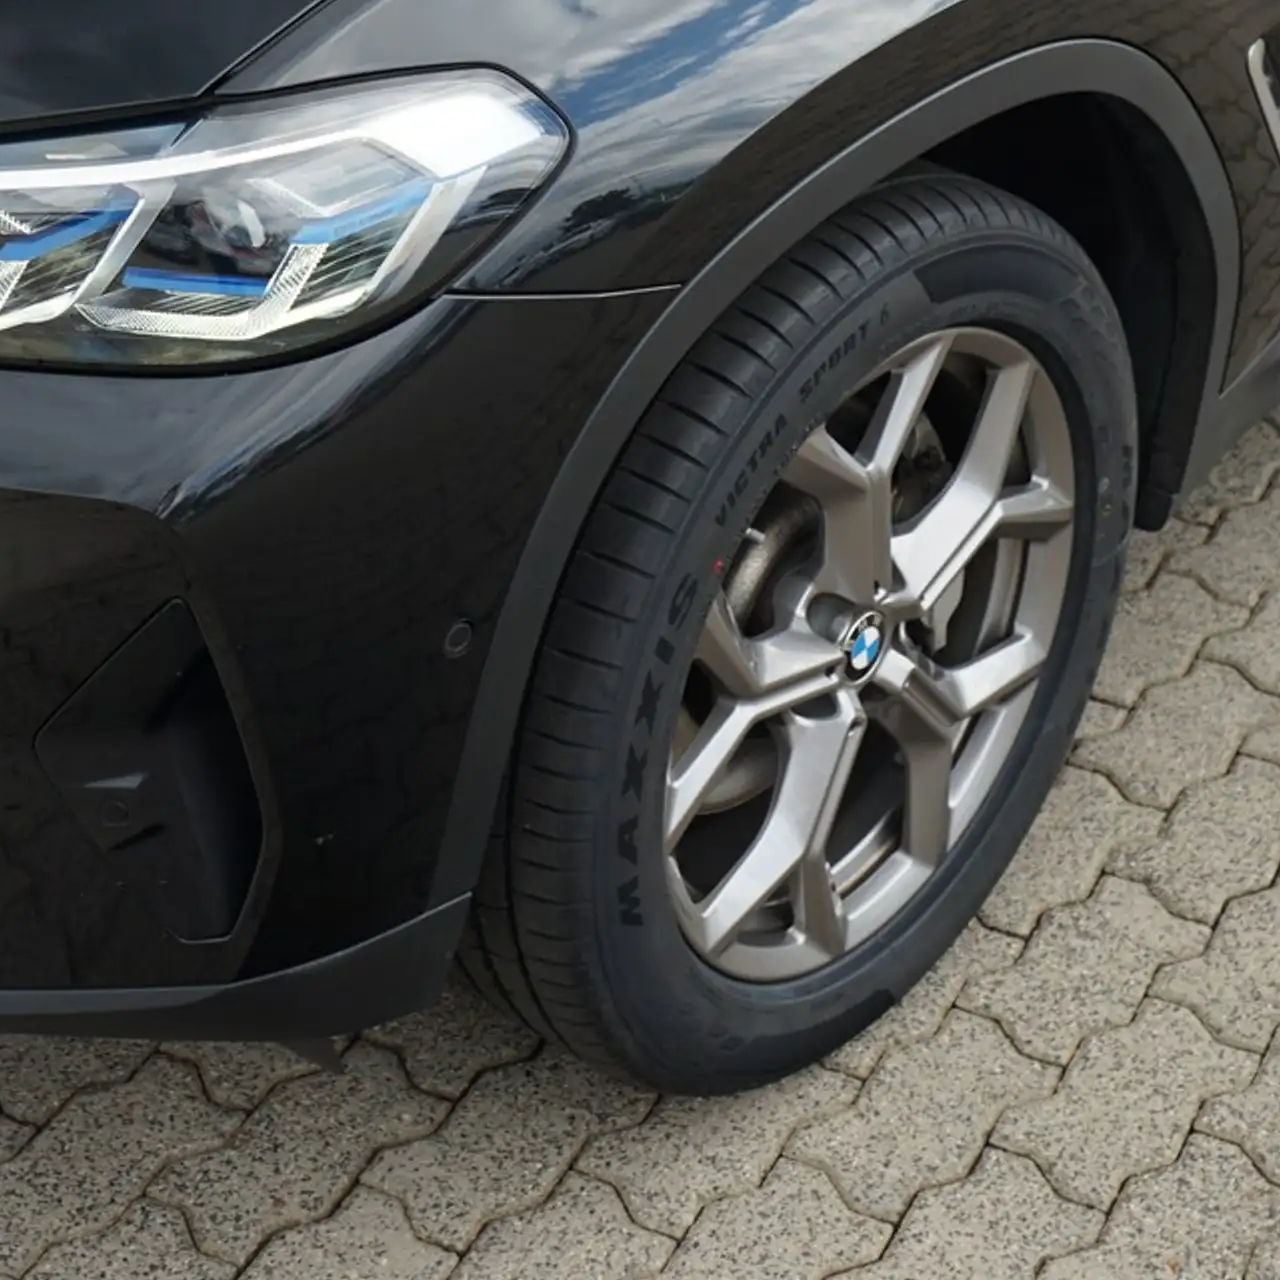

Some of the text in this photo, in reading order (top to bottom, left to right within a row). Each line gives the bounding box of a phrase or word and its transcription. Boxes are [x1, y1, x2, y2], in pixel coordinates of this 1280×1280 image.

[715, 412, 787, 527] VICTRA
[798, 318, 870, 404] SPORT
[615, 572, 699, 926] MAXXIS
